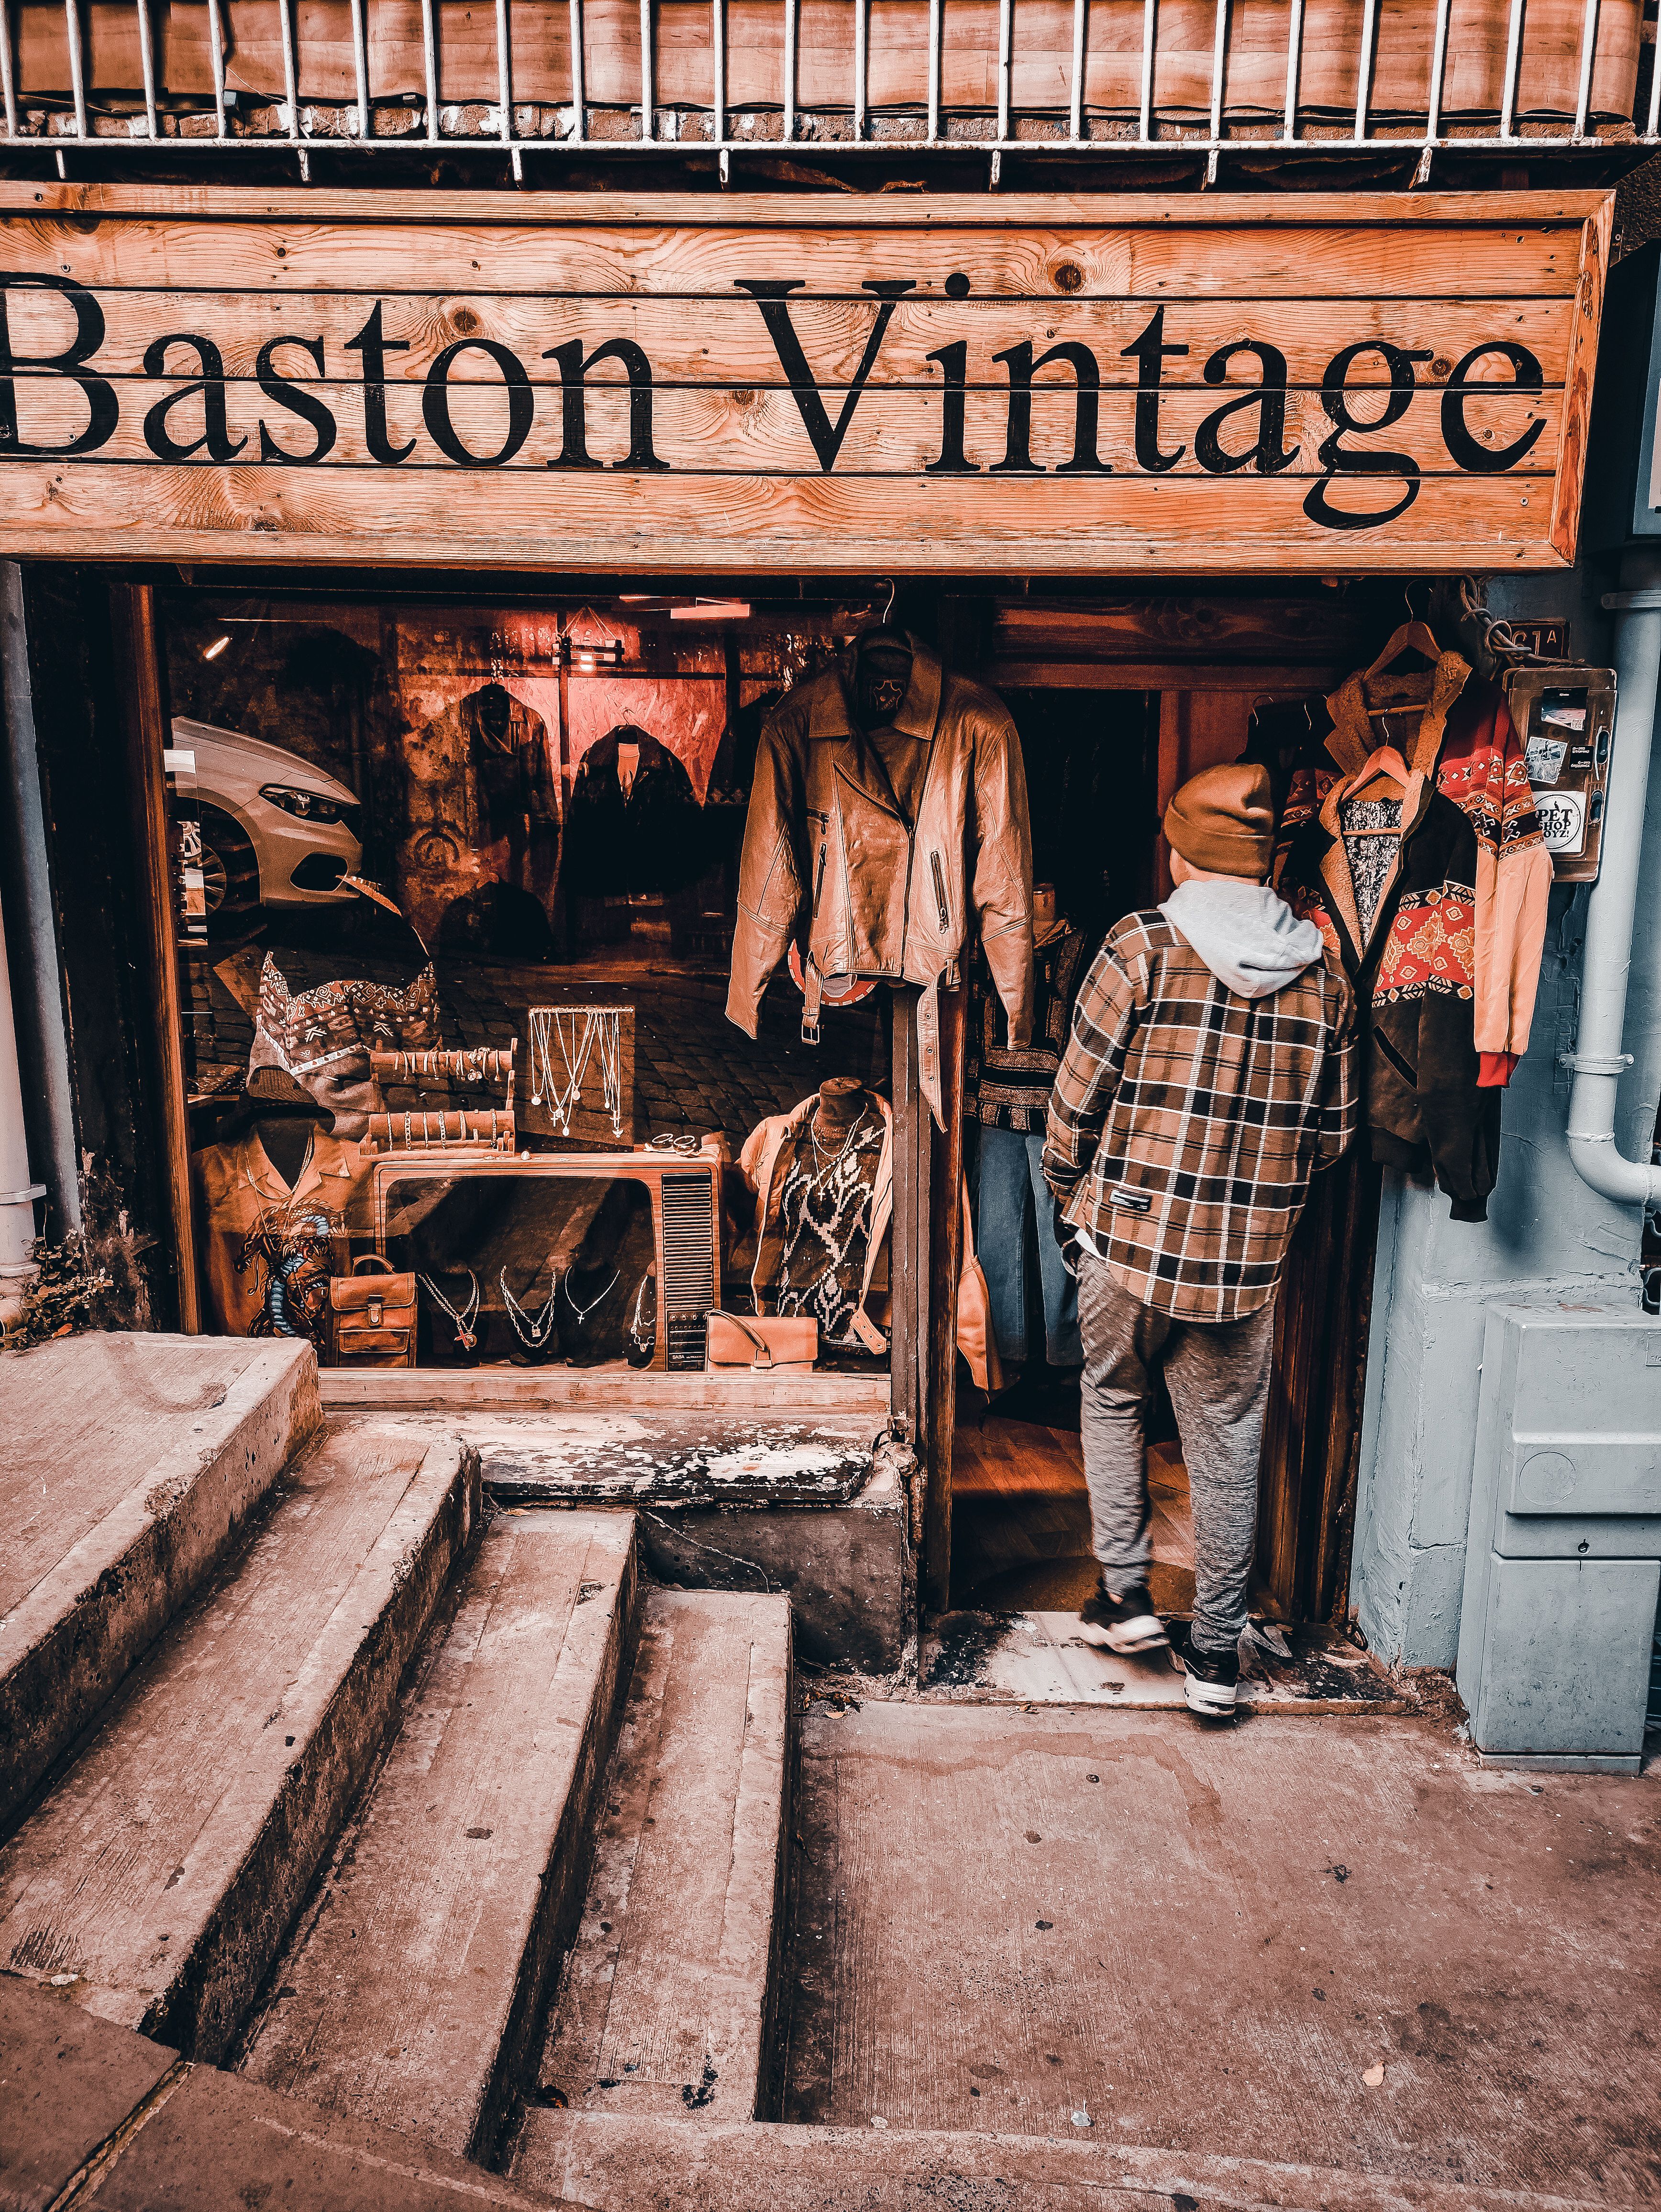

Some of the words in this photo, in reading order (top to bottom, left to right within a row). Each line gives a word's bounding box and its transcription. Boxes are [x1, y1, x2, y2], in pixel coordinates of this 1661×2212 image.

[0, 272, 671, 470] Baston
[733, 272, 1548, 531] Vintage
[1537, 809, 1572, 821] PET
